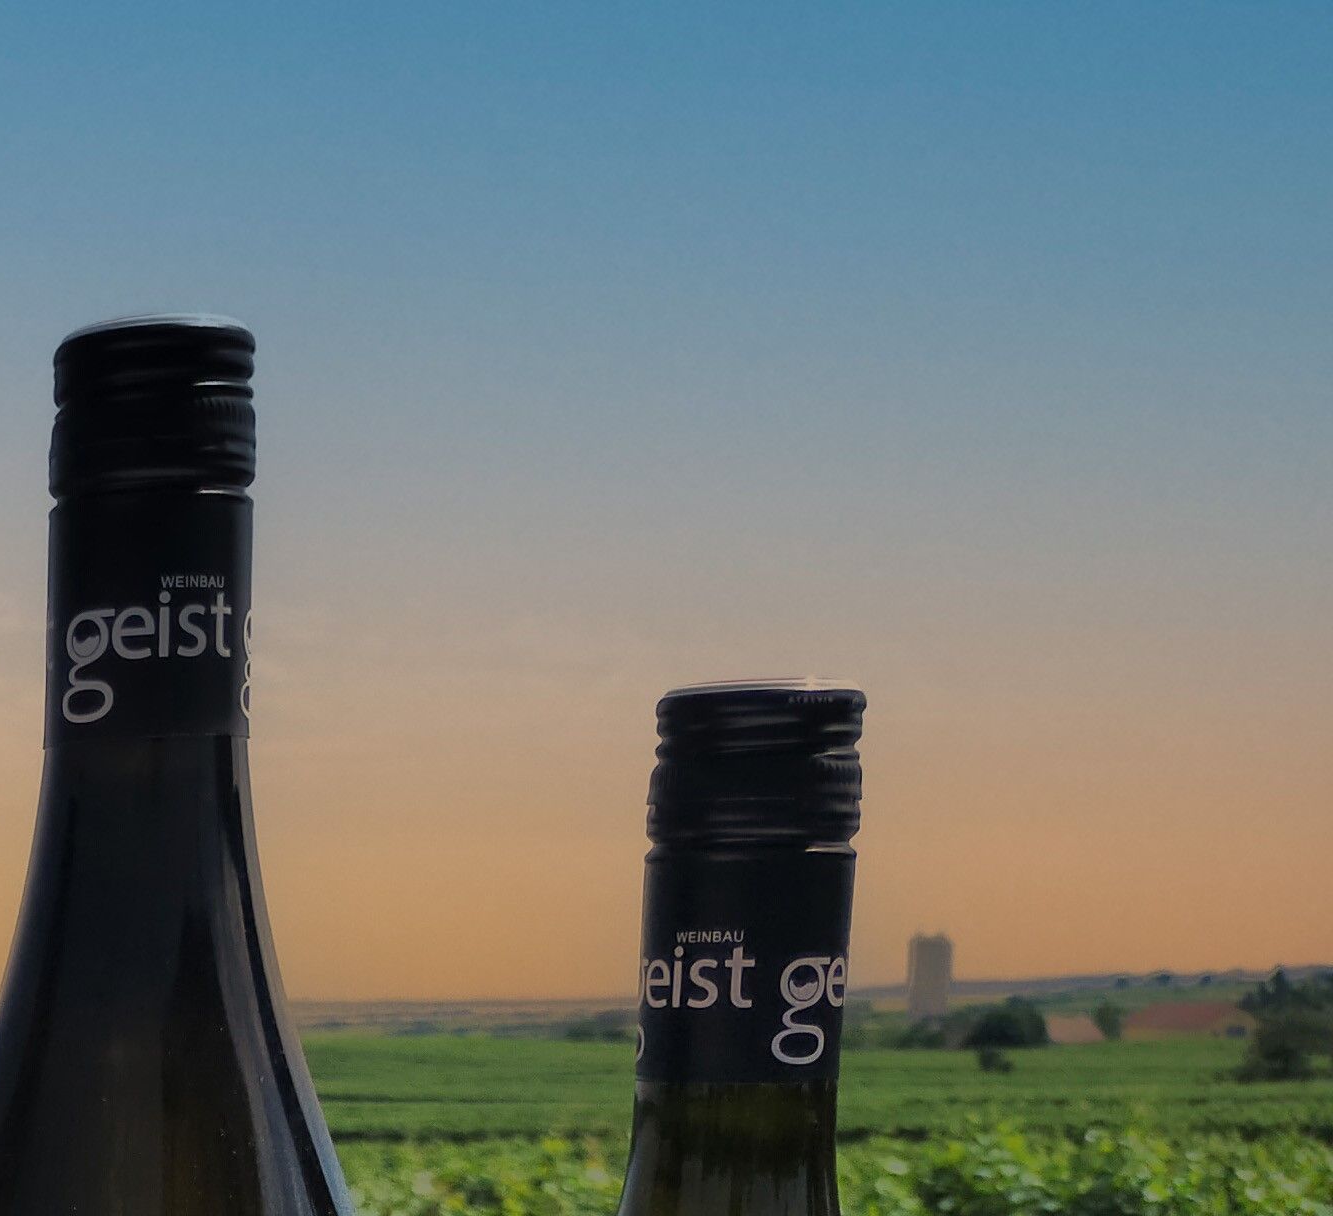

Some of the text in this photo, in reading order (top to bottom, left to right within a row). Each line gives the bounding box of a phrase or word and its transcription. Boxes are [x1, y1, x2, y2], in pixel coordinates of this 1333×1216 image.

[161, 575, 224, 589] WEINBAU
[62, 590, 231, 723] geist
[676, 930, 745, 944] WEINBAU
